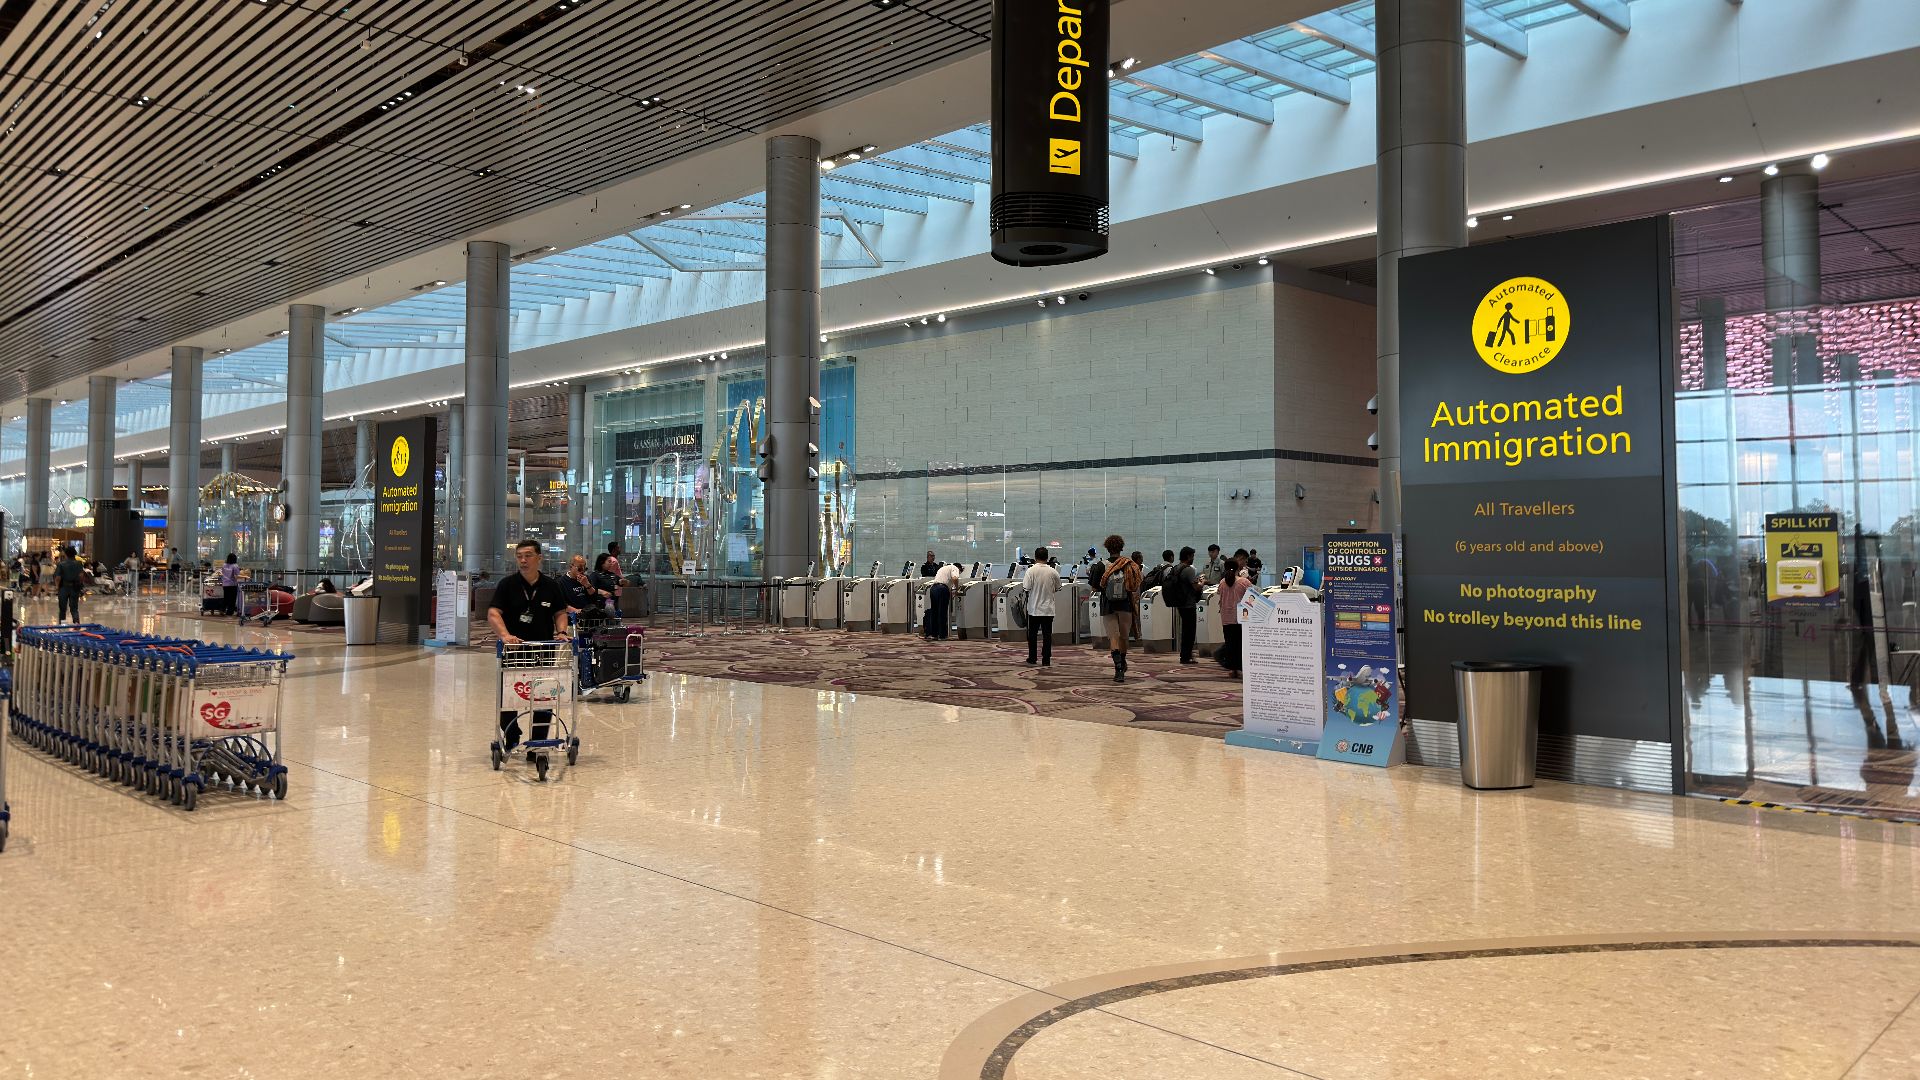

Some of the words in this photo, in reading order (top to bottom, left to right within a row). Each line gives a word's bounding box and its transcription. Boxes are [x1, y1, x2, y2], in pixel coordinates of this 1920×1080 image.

[1488, 283, 1555, 308] Automated
[1493, 346, 1551, 367] Clearance
[1431, 385, 1623, 428] Automated
[1424, 427, 1631, 467] Immigration
[382, 483, 418, 498] Automated
[380, 499, 418, 514] Immigration
[1474, 501, 1495, 516] All
[1500, 501, 1575, 516] Travellers
[1771, 517, 1806, 528] SPILL
[1808, 517, 1831, 528] KIT
[1455, 540, 1467, 553] (6
[1469, 542, 1502, 554] years
[1505, 541, 1526, 552] old
[1530, 540, 1554, 552] and
[1558, 540, 1604, 553] above)
[1328, 555, 1371, 566] DRUGS
[1460, 584, 1483, 598] No
[1486, 584, 1596, 604] photography
[1276, 607, 1290, 615] Your
[1277, 616, 1300, 624] personal
[1300, 616, 1313, 624] data
[1423, 609, 1445, 623] No
[1448, 610, 1500, 629] trolley
[1503, 611, 1567, 630] beyond
[1571, 613, 1604, 629] this
[1608, 614, 1642, 630] line
[204, 707, 226, 720] SG
[1351, 742, 1374, 755] CNB
